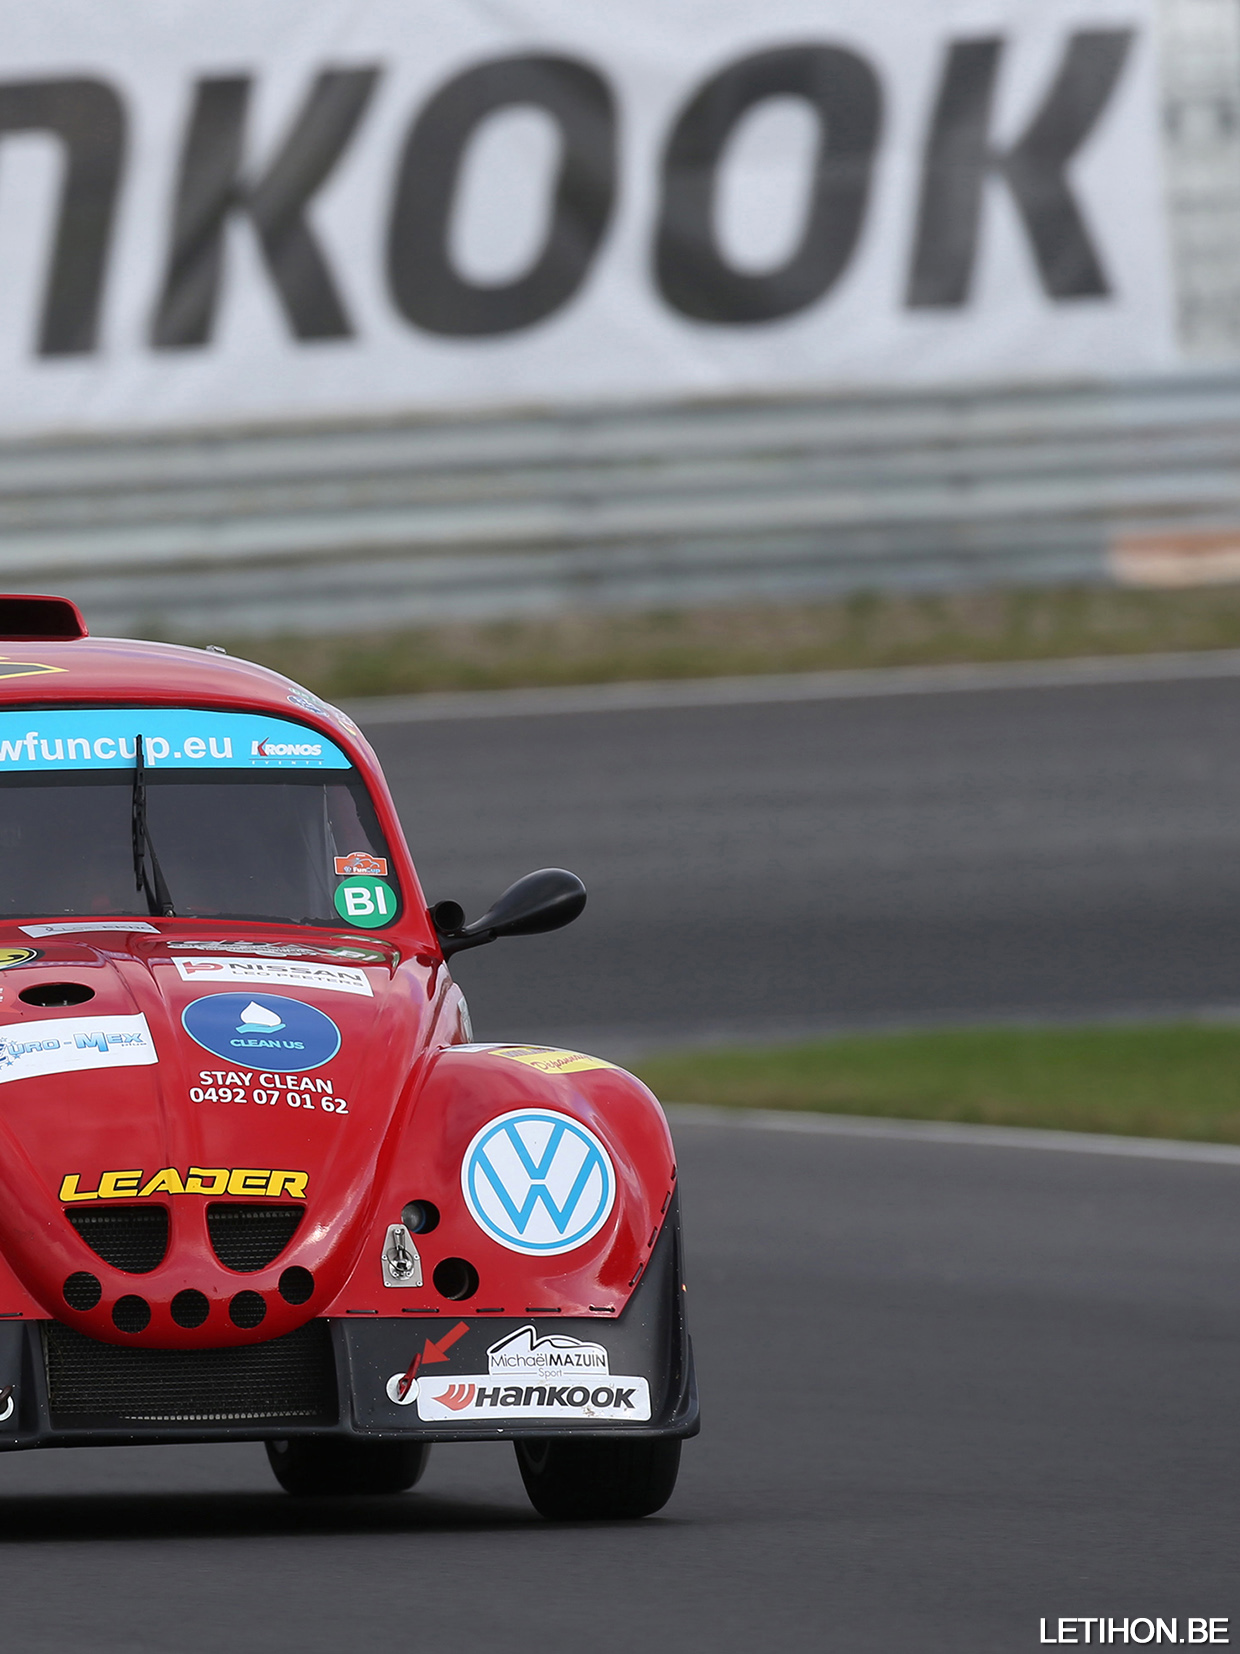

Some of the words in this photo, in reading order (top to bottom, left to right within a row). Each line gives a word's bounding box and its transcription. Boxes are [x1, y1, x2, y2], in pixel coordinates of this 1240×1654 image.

[251, 737, 322, 757] KRONOS
[344, 886, 388, 916] BI
[229, 963, 363, 982] NISSAN
[230, 1039, 281, 1049] CLEAN
[283, 1041, 305, 1050] US
[199, 1071, 253, 1087] STAY
[259, 1073, 334, 1095] CLEAN
[189, 1087, 248, 1104] 0492
[252, 1089, 280, 1106] 07
[286, 1092, 316, 1110] 01
[321, 1097, 349, 1115] 62
[59, 1167, 309, 1202] LEADER
[539, 1368, 562, 1379] Sport
